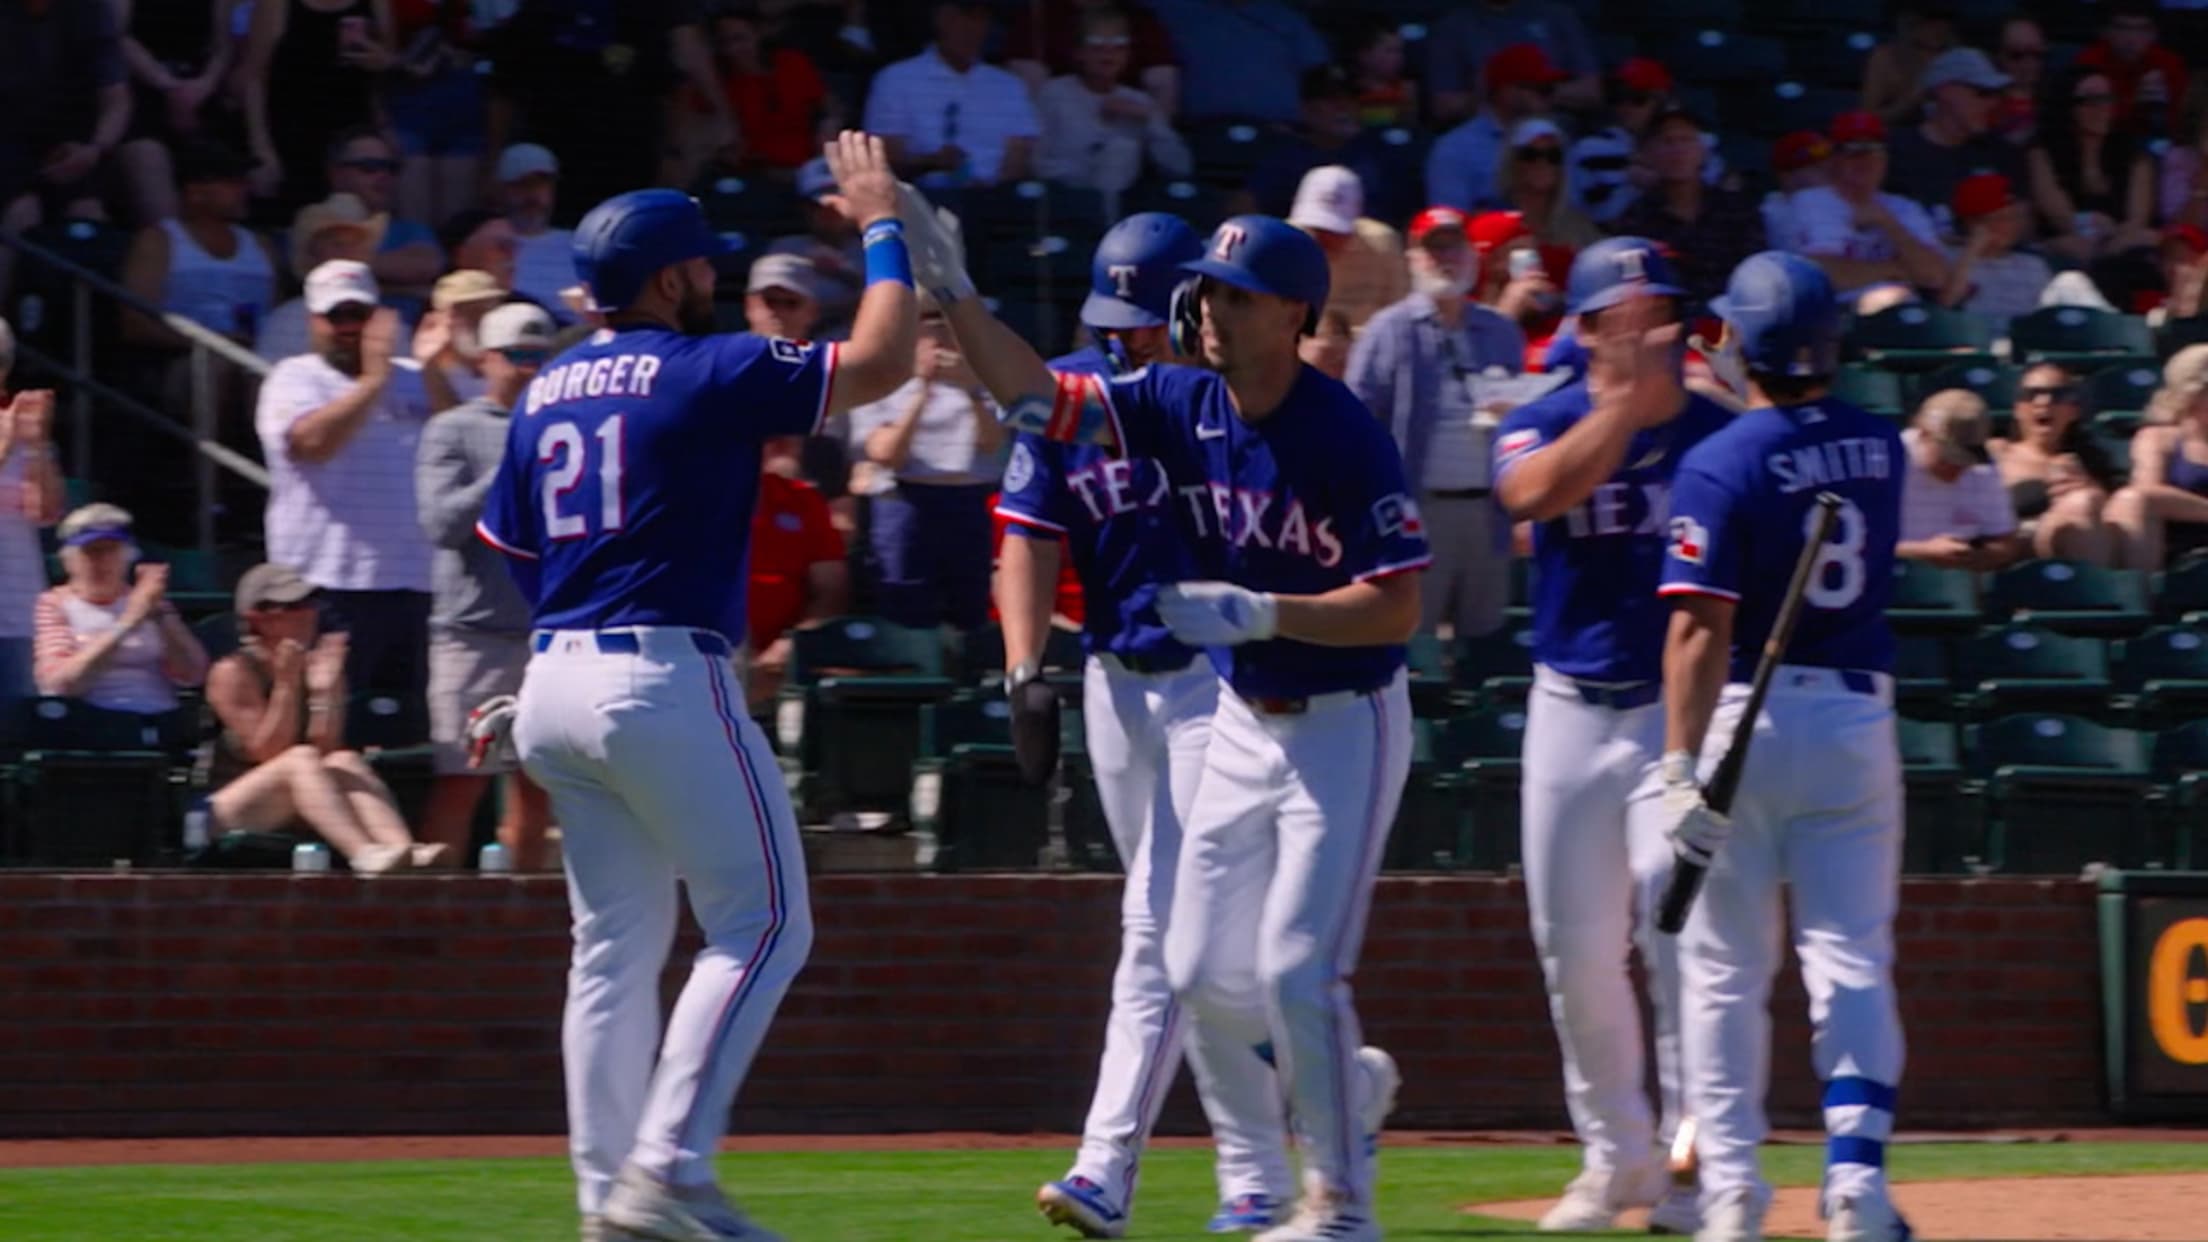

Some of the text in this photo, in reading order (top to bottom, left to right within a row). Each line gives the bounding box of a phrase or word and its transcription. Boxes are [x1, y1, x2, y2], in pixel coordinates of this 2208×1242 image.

[1216, 222, 1246, 261] T
[1109, 264, 1137, 297] T
[525, 354, 661, 416] BURGER
[537, 412, 628, 543] 21
[1767, 437, 1889, 494] SMITH
[1178, 482, 1342, 568] TEXAS
[1801, 497, 1867, 609] 8
